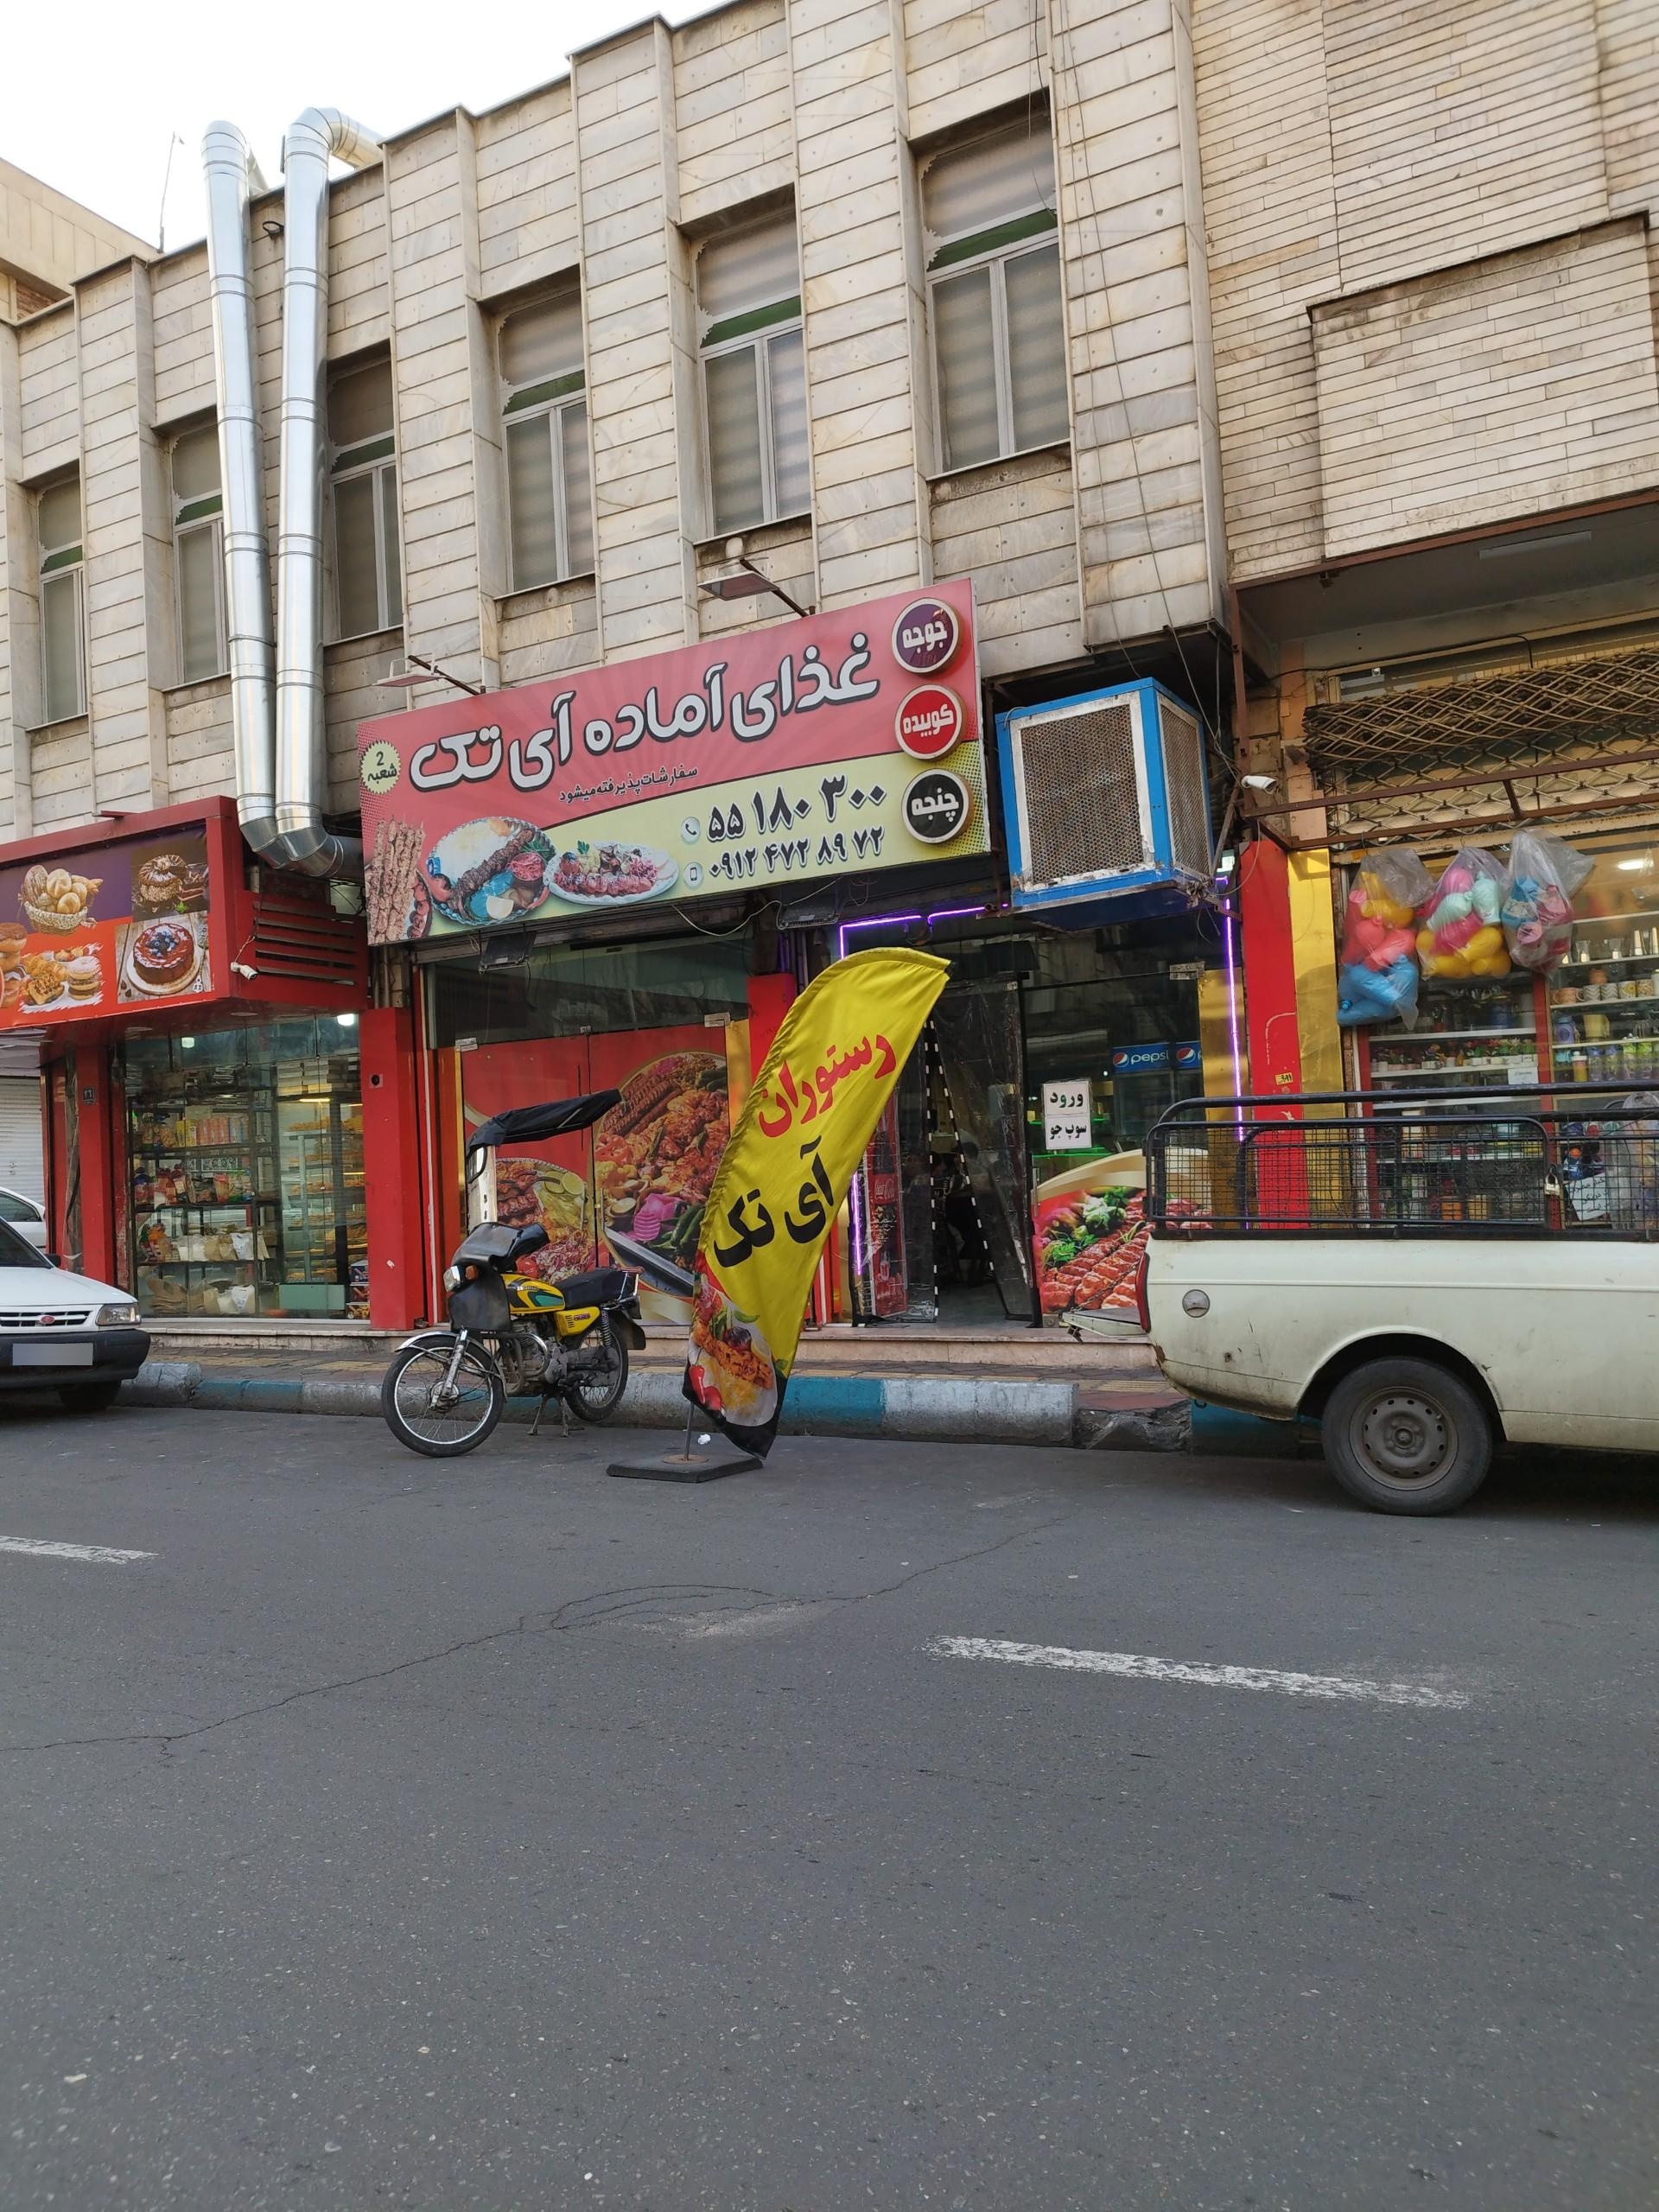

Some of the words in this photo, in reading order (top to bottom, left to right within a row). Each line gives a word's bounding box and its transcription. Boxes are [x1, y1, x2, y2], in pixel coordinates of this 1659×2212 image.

[901, 618, 948, 652] جوجه
[583, 662, 728, 755] آماده
[730, 632, 880, 743] غذای
[508, 690, 576, 792] آی
[902, 702, 955, 739] کوبیده
[367, 763, 397, 783] شعبه
[409, 724, 503, 793] تک
[911, 787, 959, 822] چنجه
[759, 1033, 897, 1138] رستوران
[1049, 1090, 1084, 1109] ورود
[1049, 1122, 1063, 1140] جو
[1065, 1123, 1087, 1141] سوپ
[784, 1135, 835, 1244] آی
[713, 1188, 775, 1268] تک
